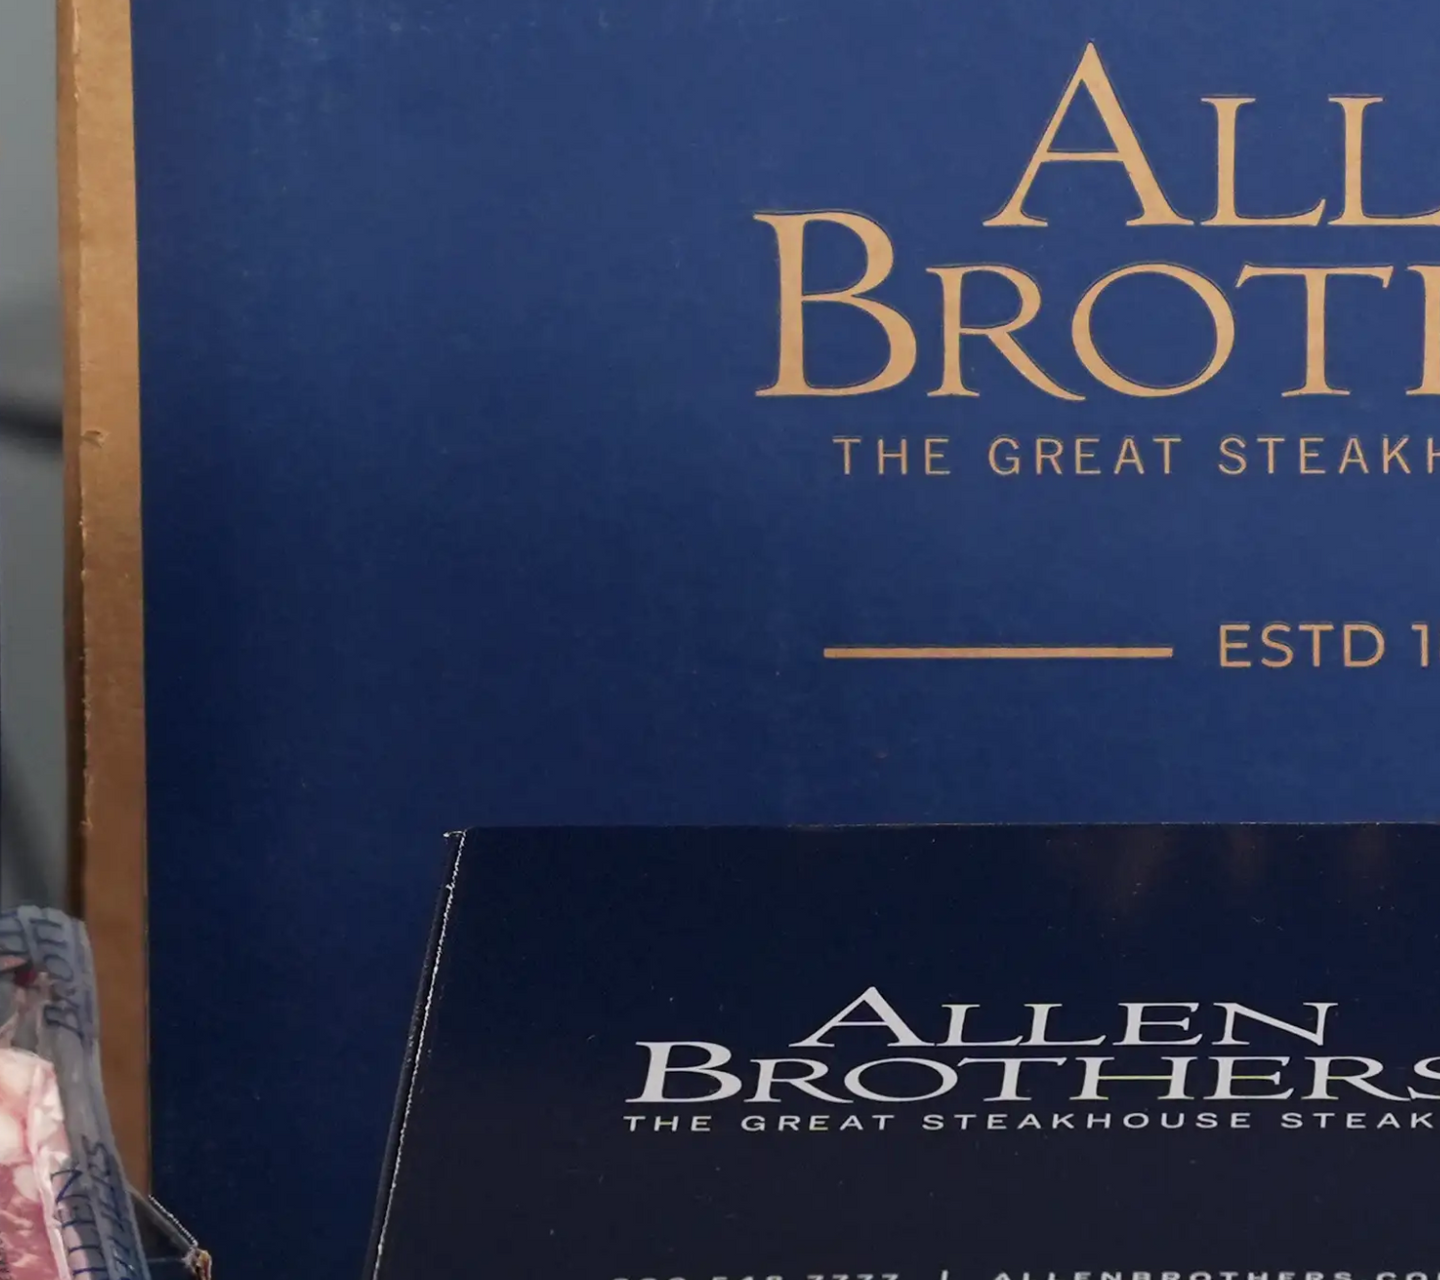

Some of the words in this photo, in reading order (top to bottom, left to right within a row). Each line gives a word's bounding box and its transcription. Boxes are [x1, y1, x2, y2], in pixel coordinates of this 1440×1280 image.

[833, 437, 948, 475] THE
[988, 436, 1181, 475] GREAT
[1218, 623, 1385, 668] ESTD
[788, 986, 1339, 1048] ALLEN
[623, 1115, 712, 1132] THE
[741, 1114, 895, 1132] GREAT
[922, 1111, 1252, 1131] STEAKHOUSE
